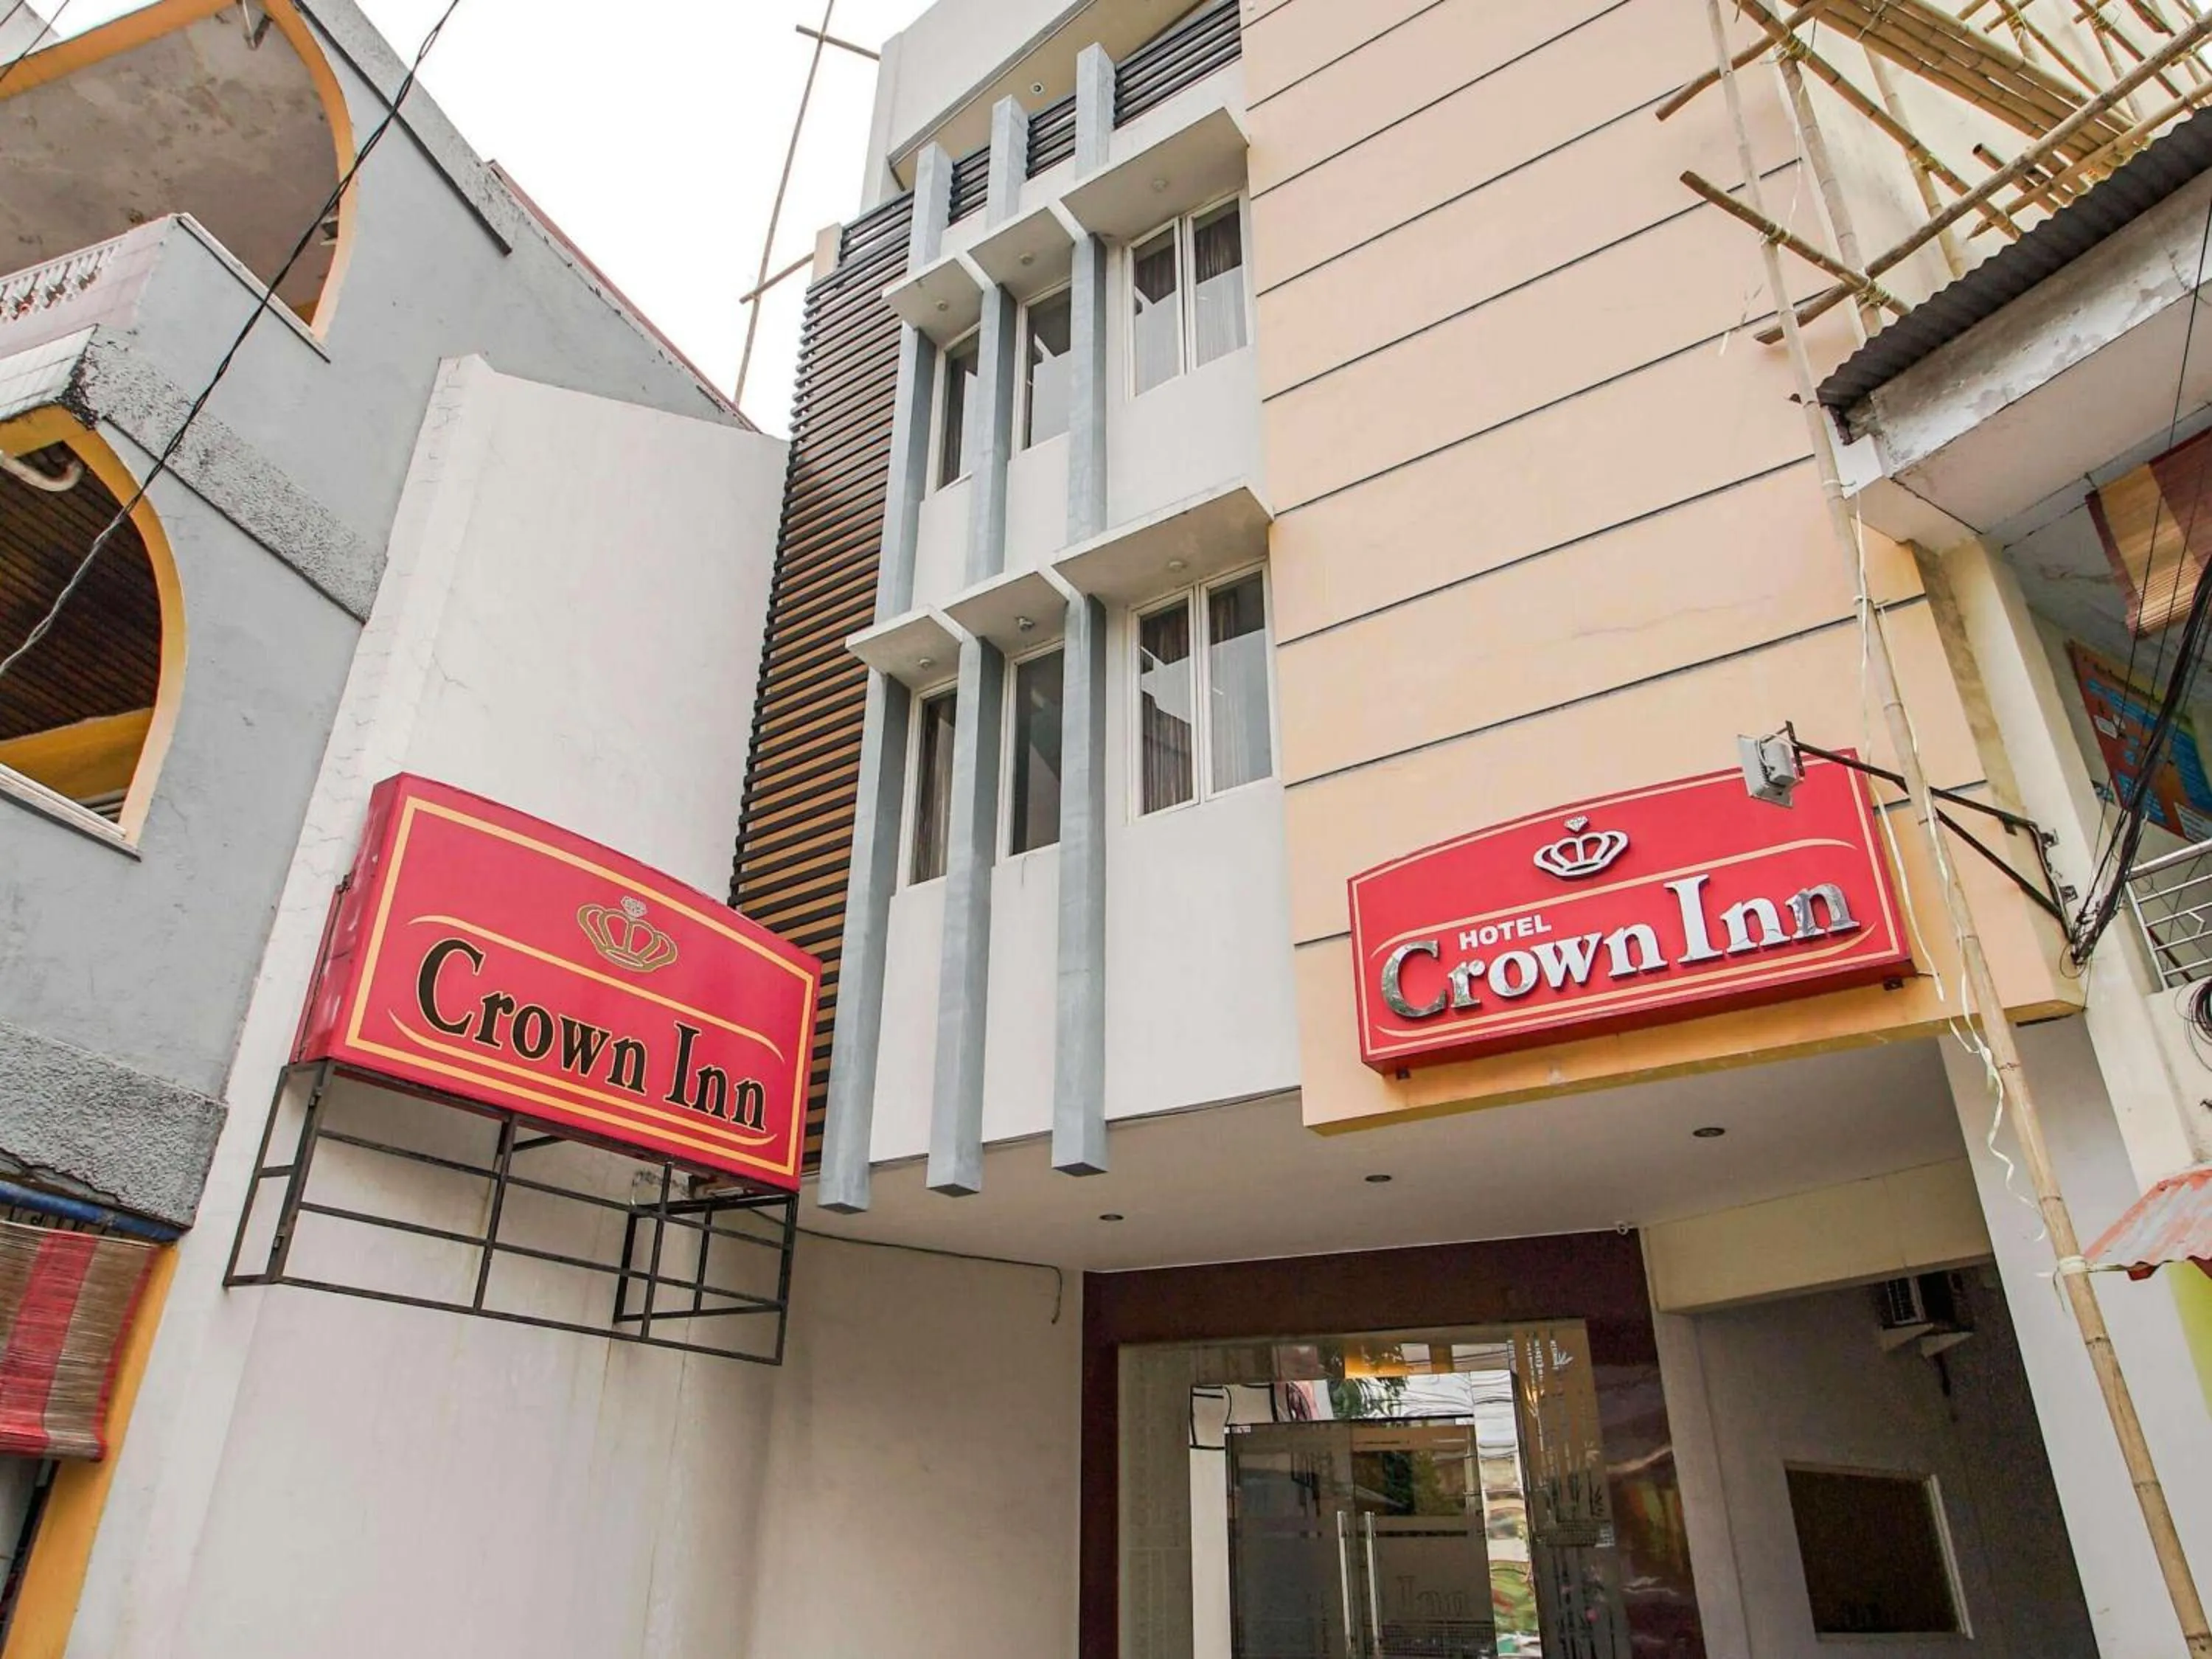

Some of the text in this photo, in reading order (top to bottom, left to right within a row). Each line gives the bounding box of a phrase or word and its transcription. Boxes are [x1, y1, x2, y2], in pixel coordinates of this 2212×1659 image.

[1381, 875, 1860, 1018] Crown Inn
[1458, 914, 1551, 951] HOTEL
[417, 938, 768, 1132] Crown Inn
